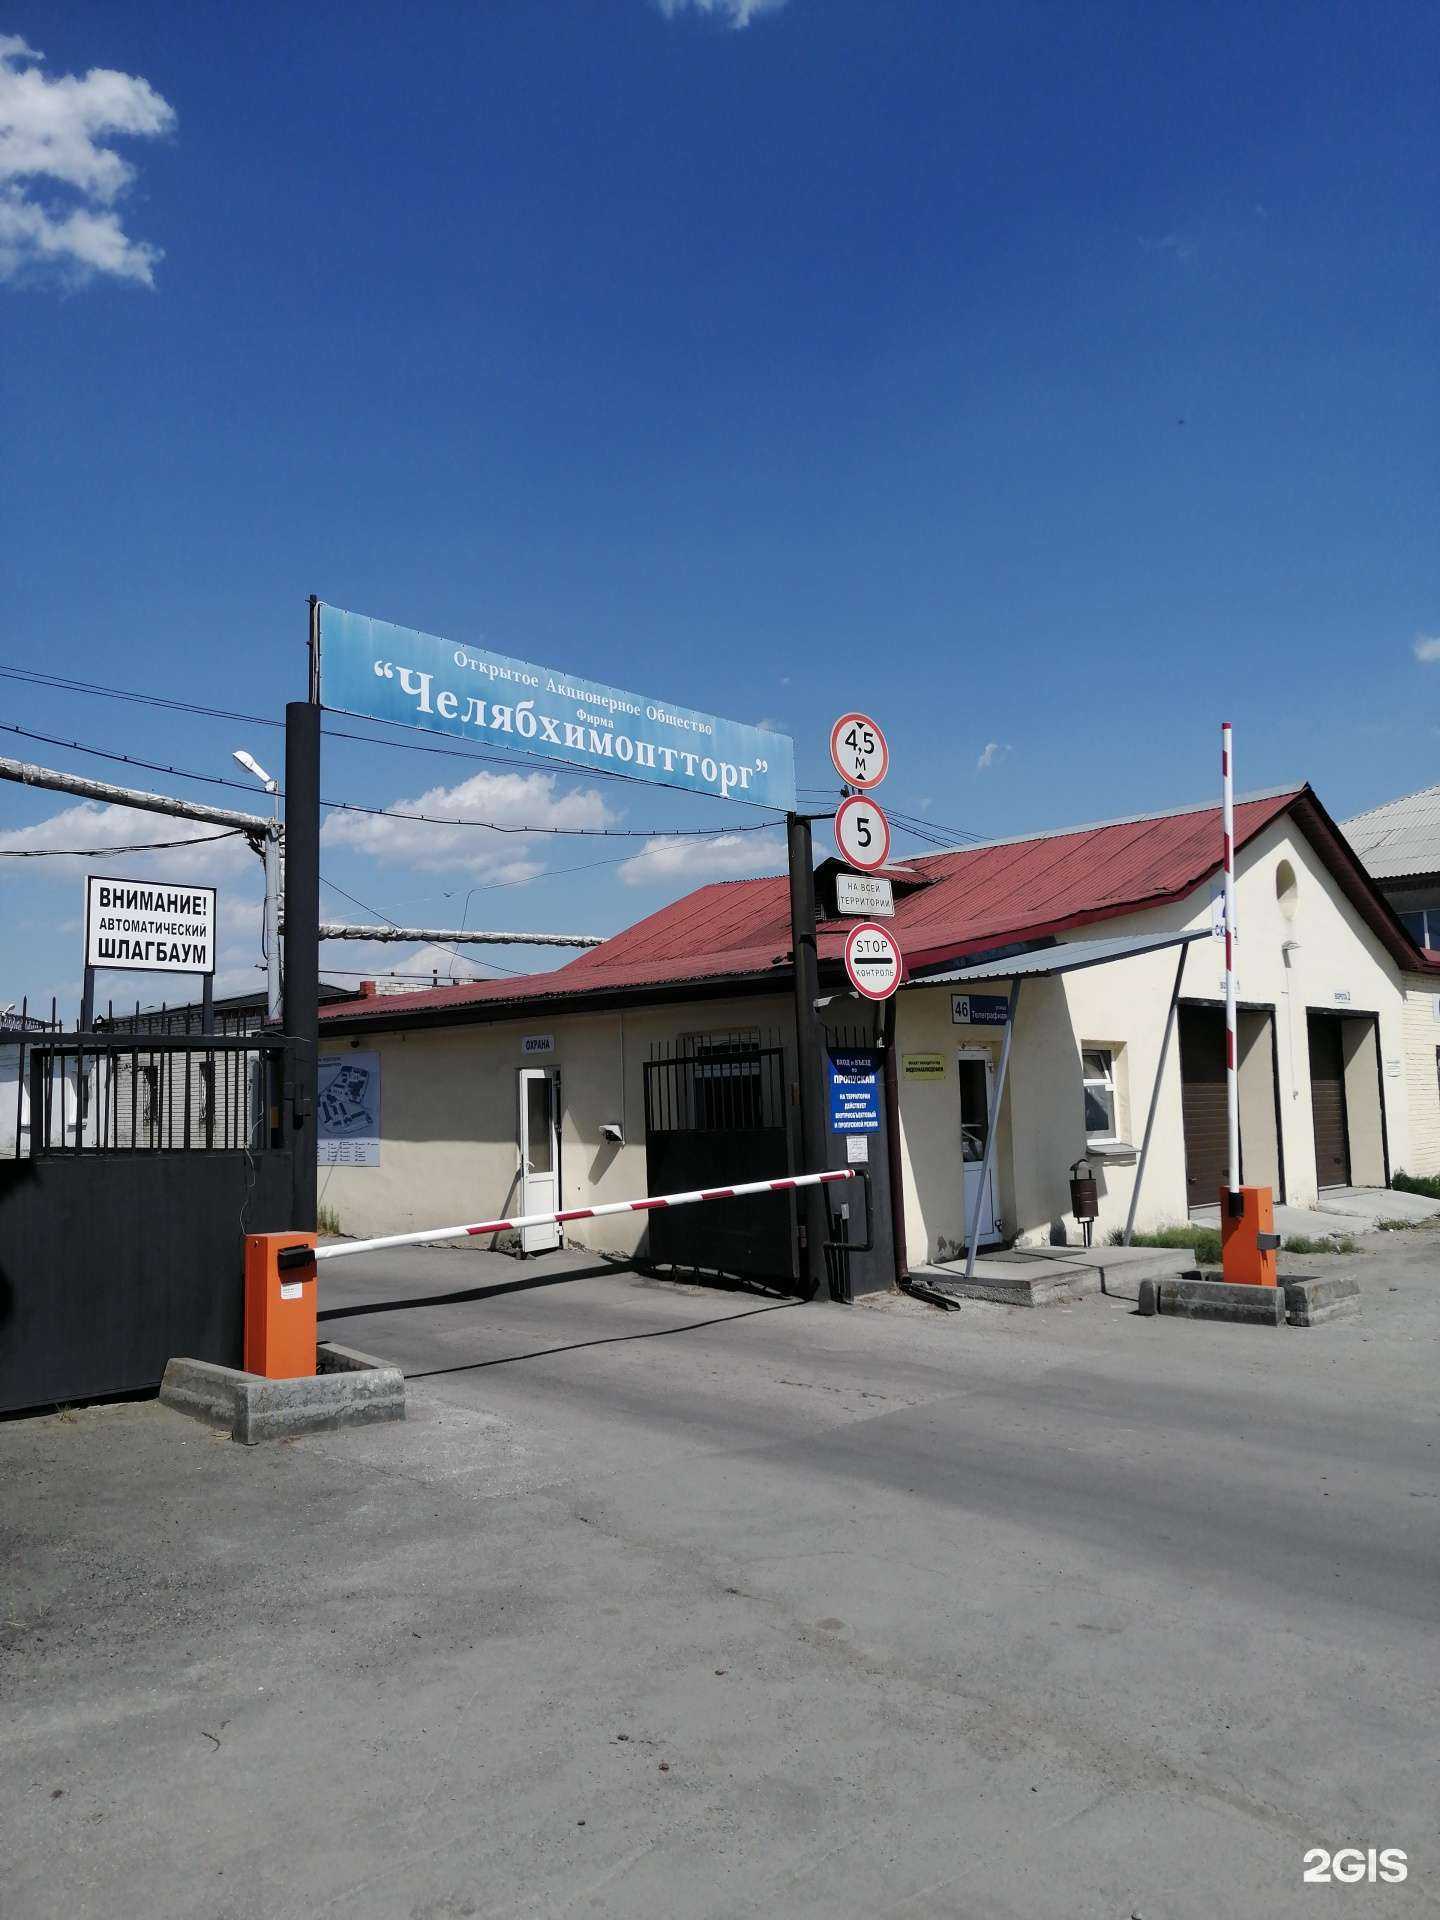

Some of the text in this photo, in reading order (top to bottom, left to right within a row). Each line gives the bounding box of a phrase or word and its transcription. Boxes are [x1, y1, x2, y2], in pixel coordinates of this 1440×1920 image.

[454, 650, 713, 736] Открытое Акционерное Общество
[576, 708, 615, 729] Фирма
[845, 729, 875, 755] 4,5
[857, 817, 872, 847] 5
[847, 882, 858, 891] НА
[99, 887, 207, 916] ВНИМАНИЕ!
[840, 896, 891, 907] ТЕРРИТОРИИ
[99, 917, 207, 938] АВТОМАТИЧЕСКИЙ
[98, 938, 206, 965] ШЛАГБАУМ
[856, 940, 888, 953] STOP
[856, 968, 894, 977] КОНТРОЛЬ
[955, 1002, 968, 1017] 46
[526, 1039, 550, 1050] ОХРАНА
[834, 1075, 875, 1084] ПРОПУСКАМ
